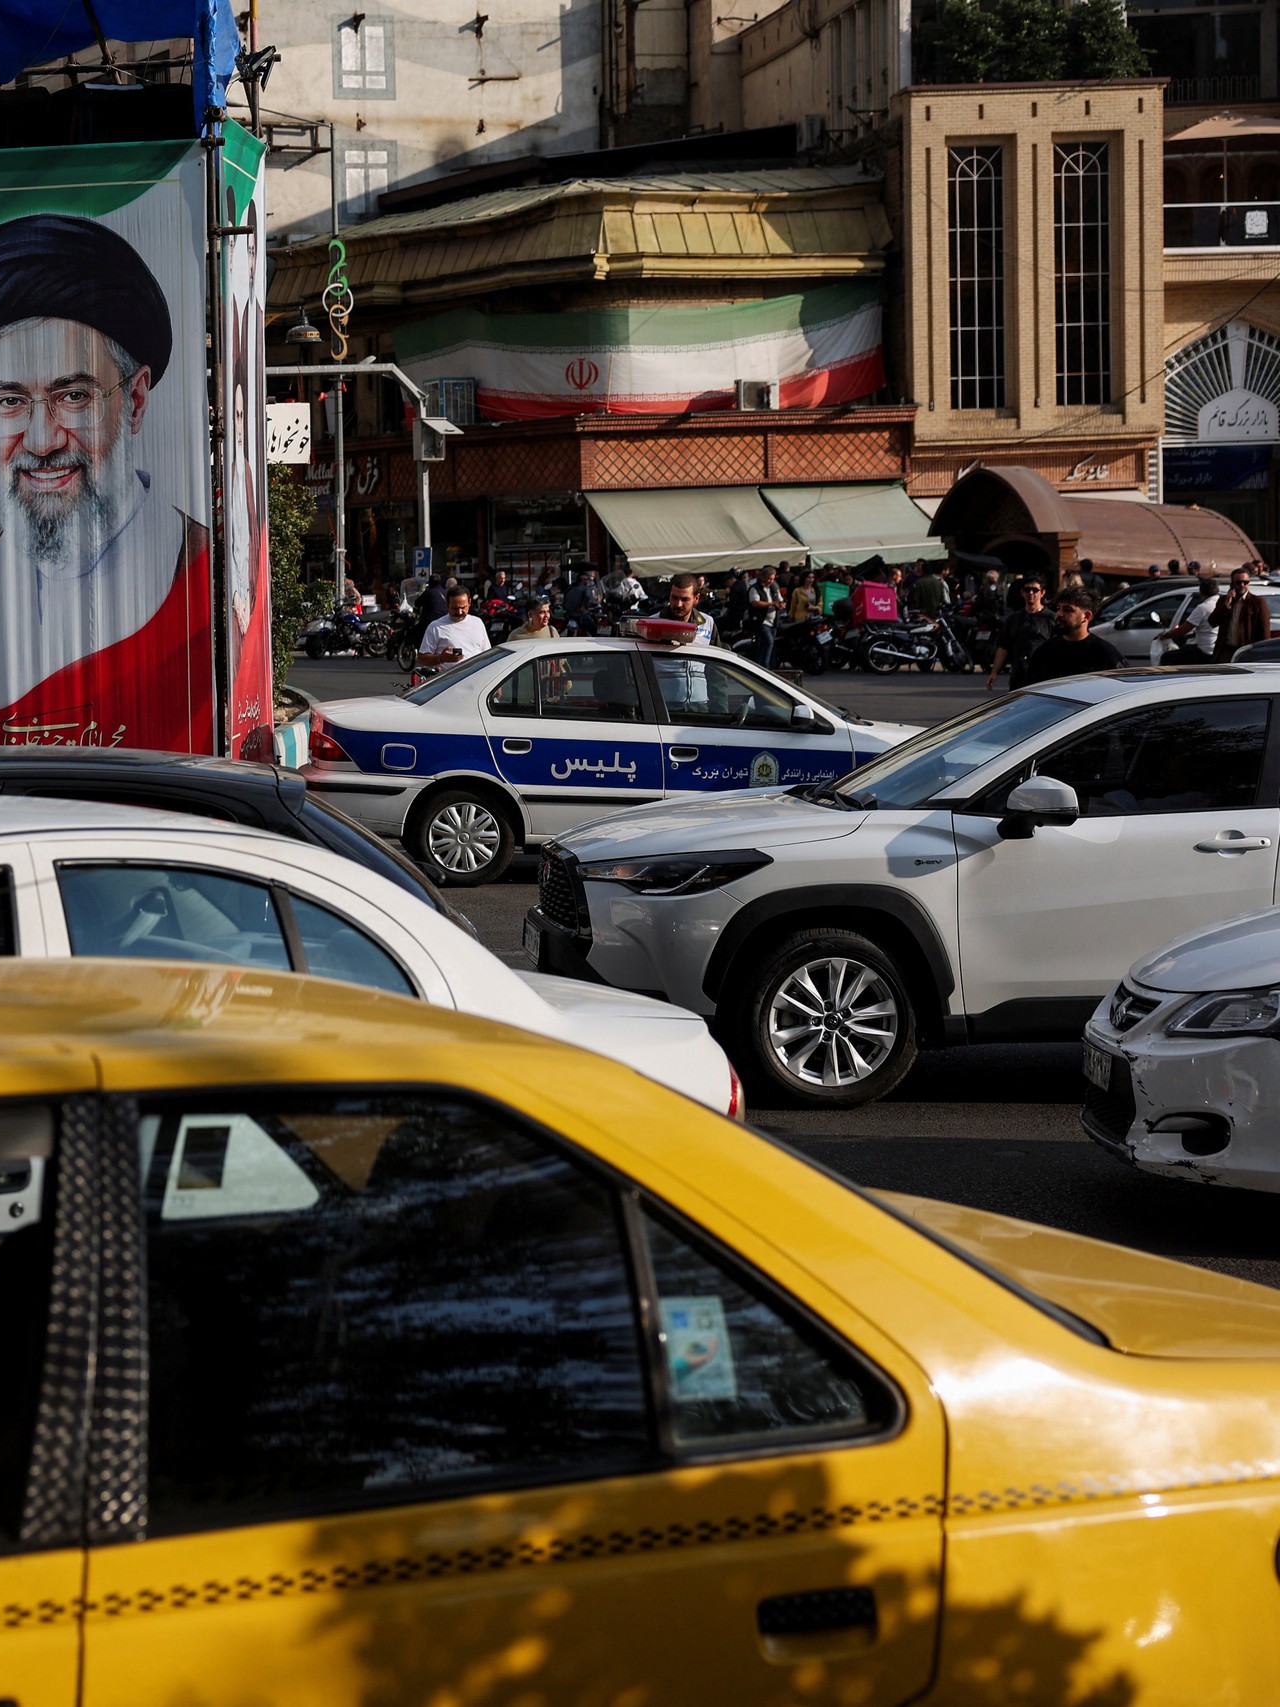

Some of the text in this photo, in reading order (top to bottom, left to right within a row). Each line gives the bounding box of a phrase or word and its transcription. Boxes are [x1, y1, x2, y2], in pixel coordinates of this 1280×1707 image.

[415, 550, 424, 566] P
[550, 751, 637, 783] پلیس
[692, 767, 719, 780] بزرگ
[722, 766, 749, 780] تهران
